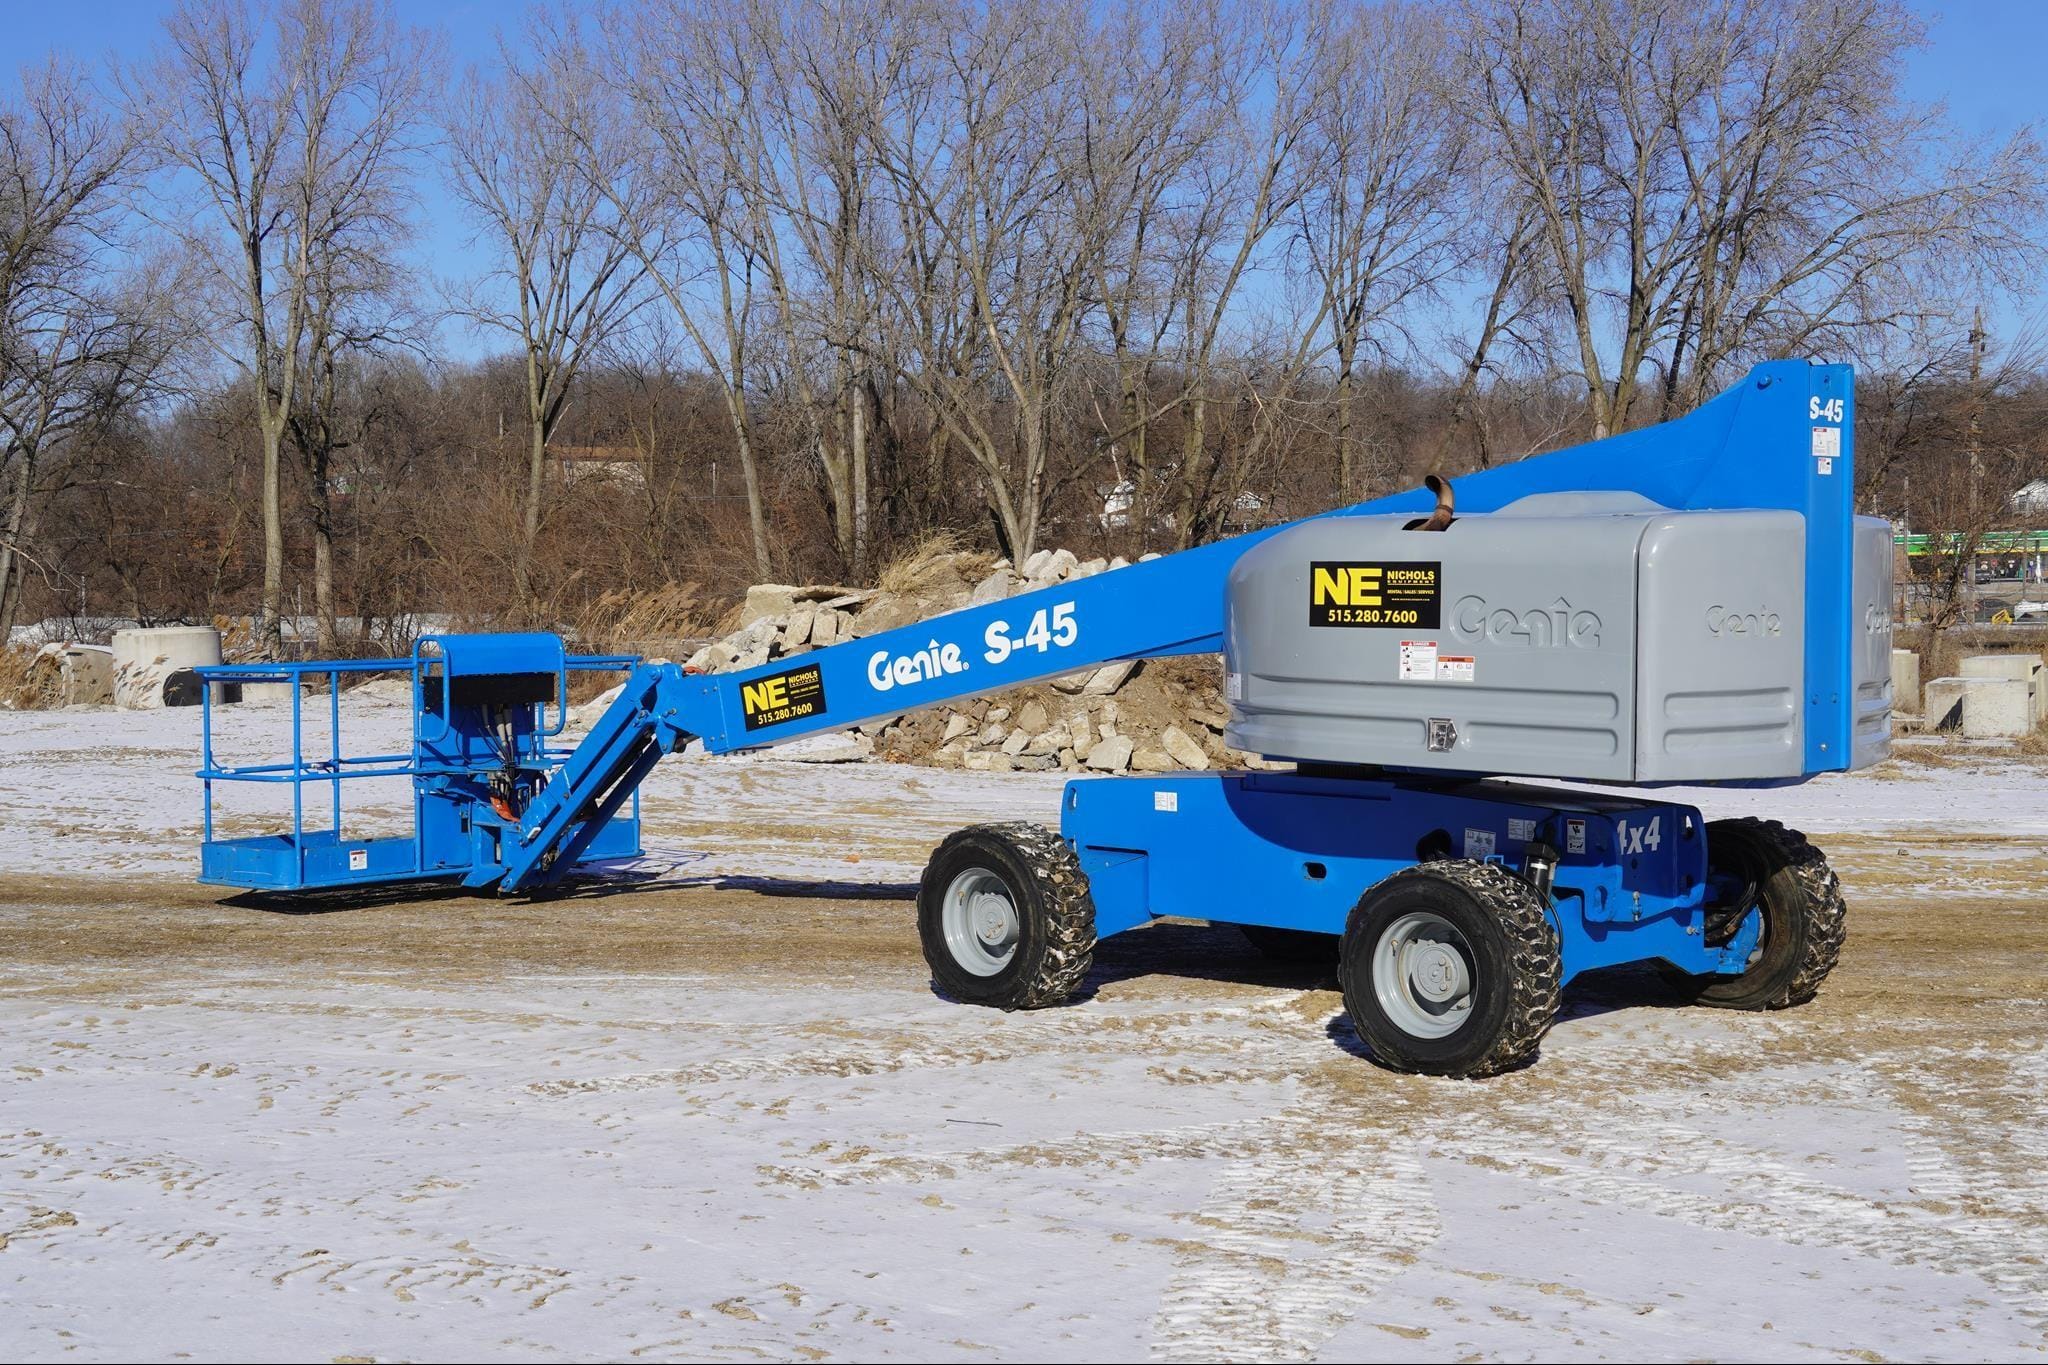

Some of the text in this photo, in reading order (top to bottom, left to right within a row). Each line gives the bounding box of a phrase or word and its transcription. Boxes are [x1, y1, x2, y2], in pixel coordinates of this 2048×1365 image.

[1810, 396, 1844, 423] S-45
[1314, 567, 1382, 606] NE
[1387, 570, 1435, 580] NICHOLS
[1328, 609, 1418, 624] 515.280.7600
[1449, 594, 1603, 649] Genie
[1705, 604, 1782, 638] Genie
[868, 600, 1079, 692] Genie S-45
[788, 670, 818, 684] NICHOLS
[742, 676, 789, 715] NE
[758, 702, 813, 725] 515.280.7600
[1617, 815, 1661, 855] 4x4
